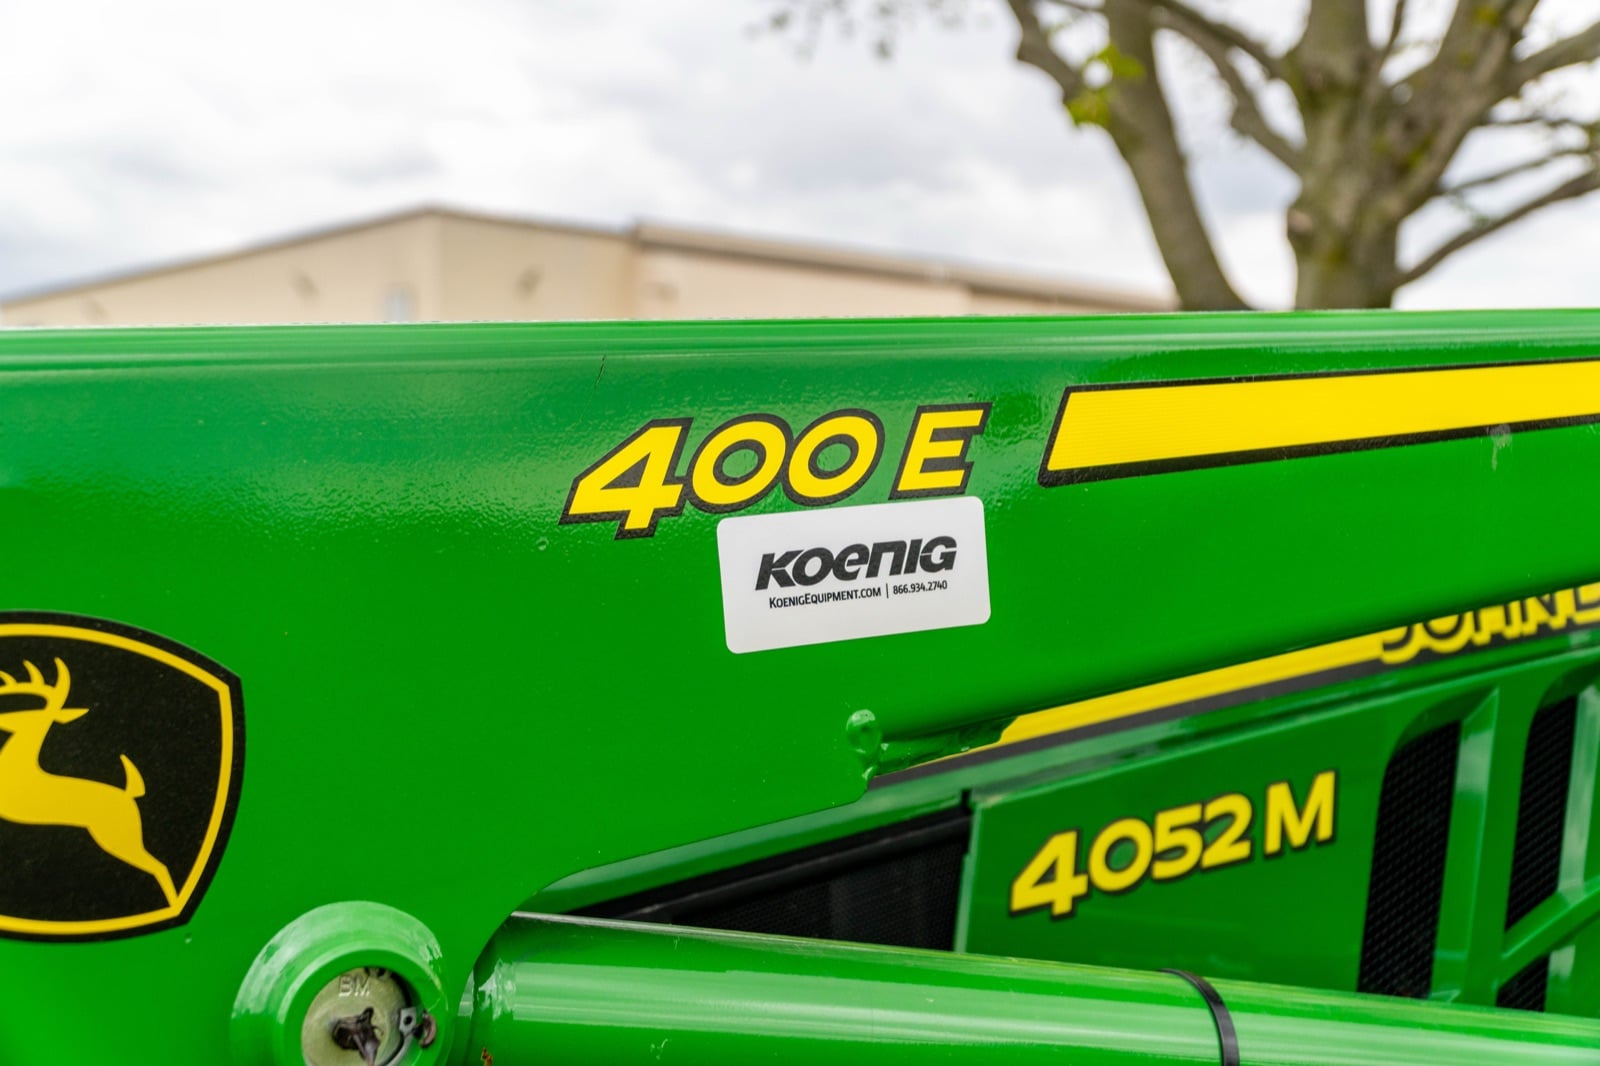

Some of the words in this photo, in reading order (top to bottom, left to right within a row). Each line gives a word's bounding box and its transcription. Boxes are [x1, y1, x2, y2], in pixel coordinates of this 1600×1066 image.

[559, 408, 885, 539] 400
[888, 402, 992, 500] E
[891, 580, 949, 596] 866.934.2740
[1008, 792, 1254, 921] 4052
[1263, 769, 1337, 860] M
